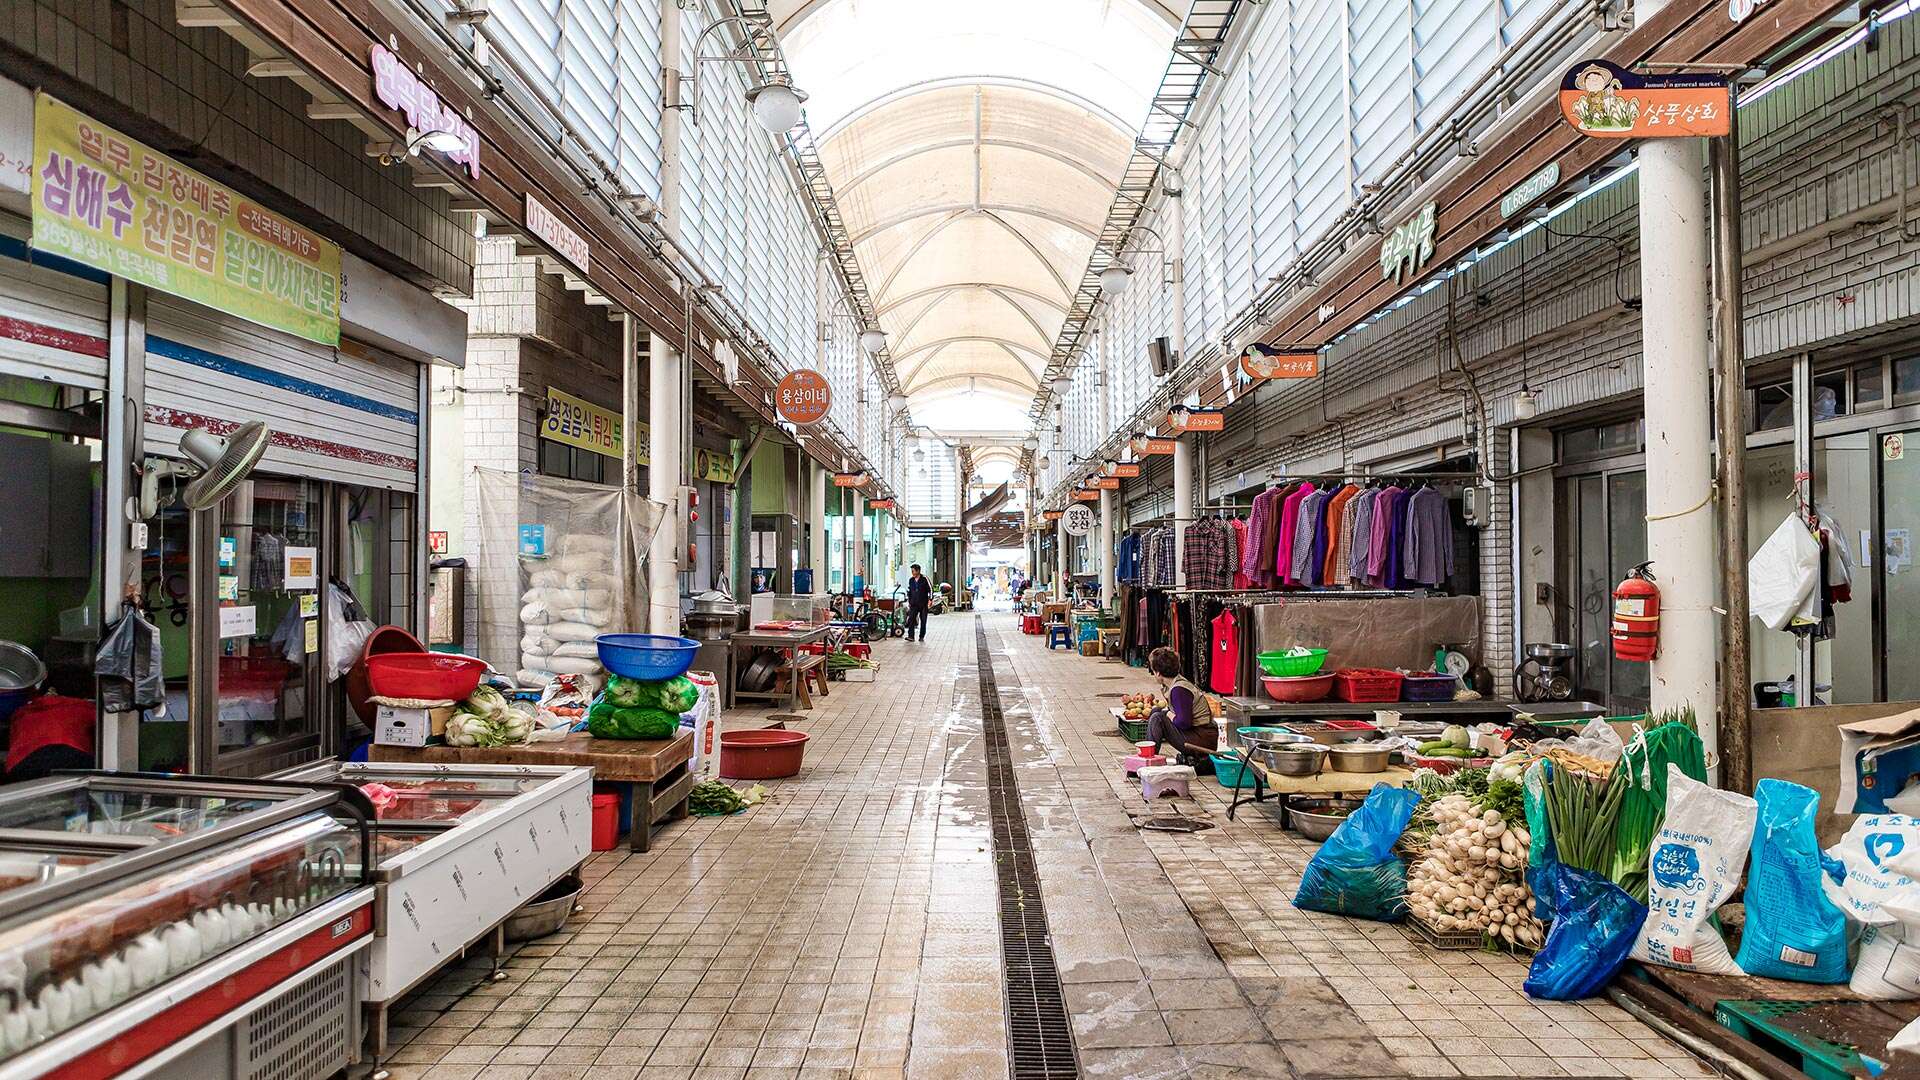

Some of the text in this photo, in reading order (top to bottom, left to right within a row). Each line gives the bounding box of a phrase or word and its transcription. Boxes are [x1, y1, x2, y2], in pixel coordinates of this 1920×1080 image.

[1643, 102, 1719, 126] 삼풍상회
[43, 152, 135, 238] 심해수
[142, 197, 217, 274] 천일염
[224, 230, 336, 318] 절임야채전문
[528, 200, 587, 266] 017-379-5436
[782, 388, 827, 404] 용삼이네
[1650, 888, 1696, 919] 천일염
[1660, 922, 1680, 936] 20kg
